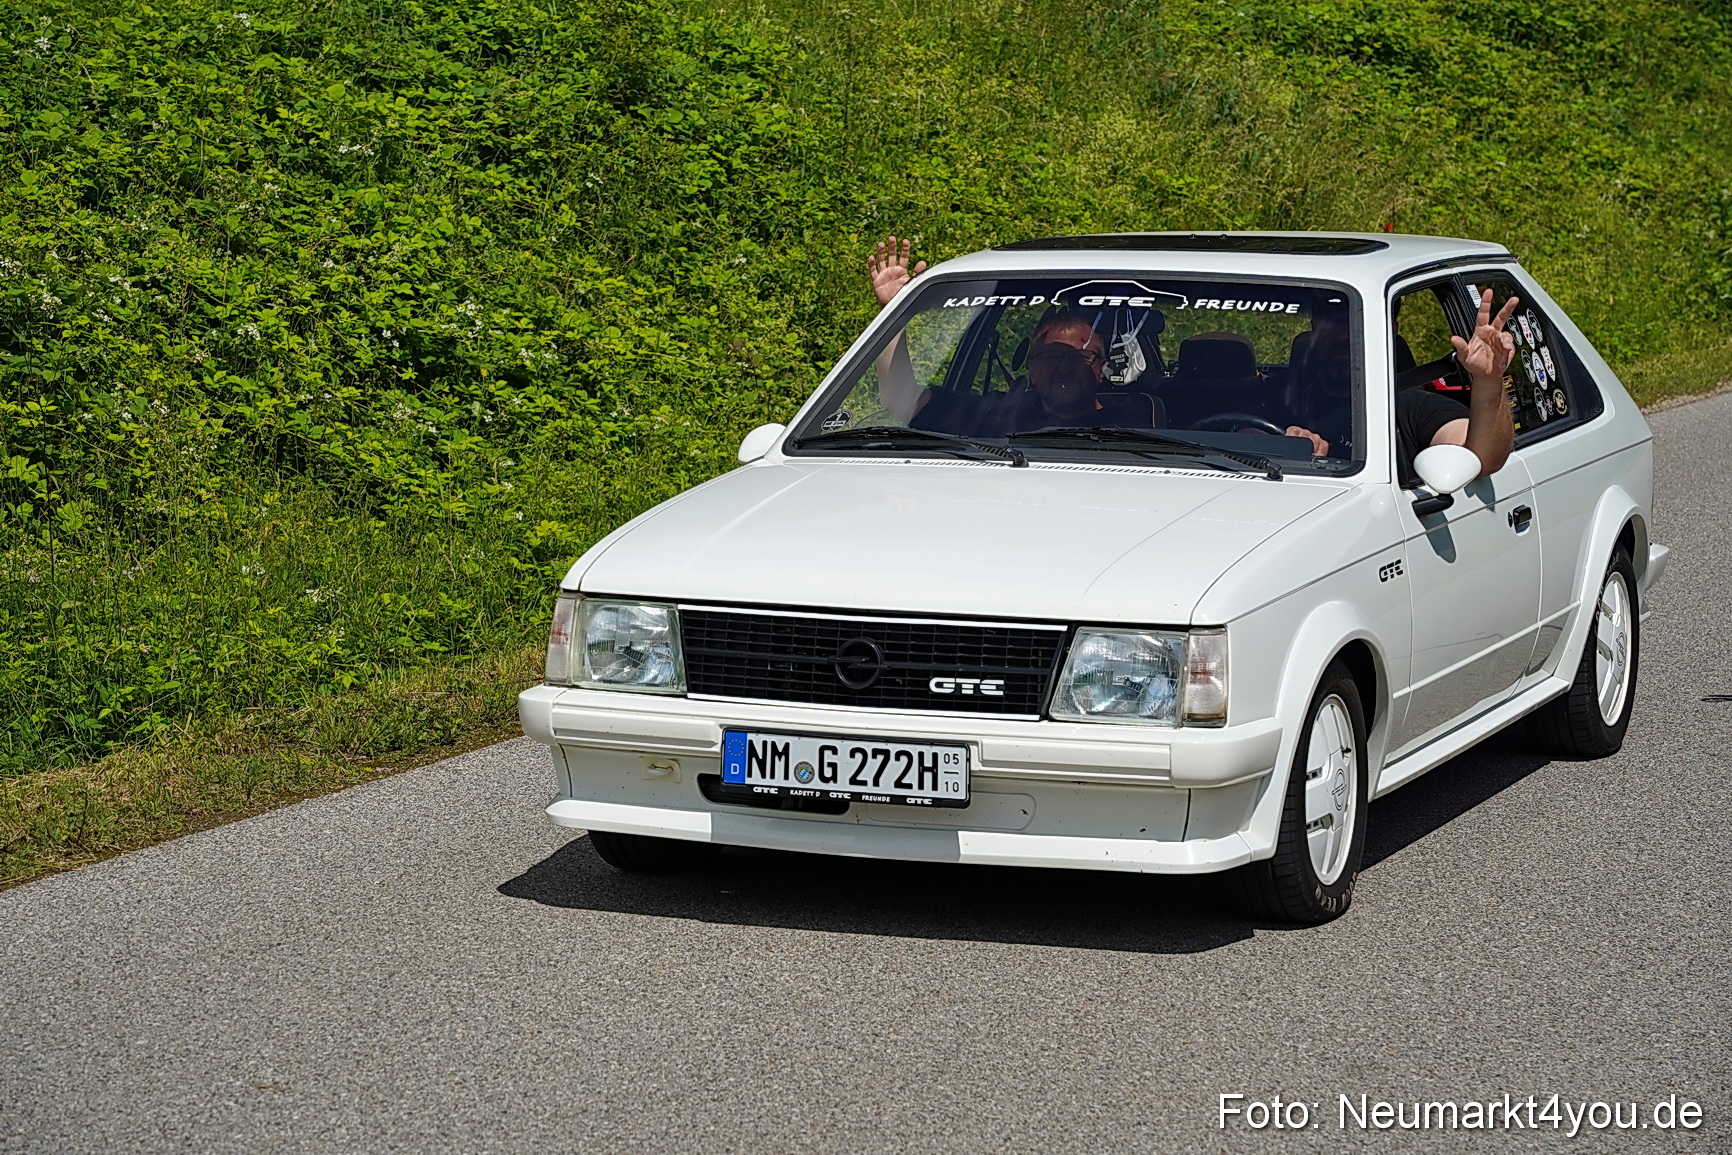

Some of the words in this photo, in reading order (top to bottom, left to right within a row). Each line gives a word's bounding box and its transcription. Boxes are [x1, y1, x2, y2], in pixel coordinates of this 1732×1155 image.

[943, 295, 1026, 309] KADETT
[1030, 296, 1045, 306] D
[1079, 296, 1155, 307] GTE
[1194, 298, 1300, 314] FREUNDE
[1378, 558, 1404, 583] GTE
[929, 677, 1005, 696] GTE
[746, 739, 791, 781] NM
[818, 744, 839, 785] G
[848, 746, 939, 792] 272H
[943, 752, 960, 765] 05
[731, 762, 740, 775] D
[944, 780, 960, 793] 10
[790, 788, 813, 797] KADETT
[862, 794, 890, 803] FREUNDE
